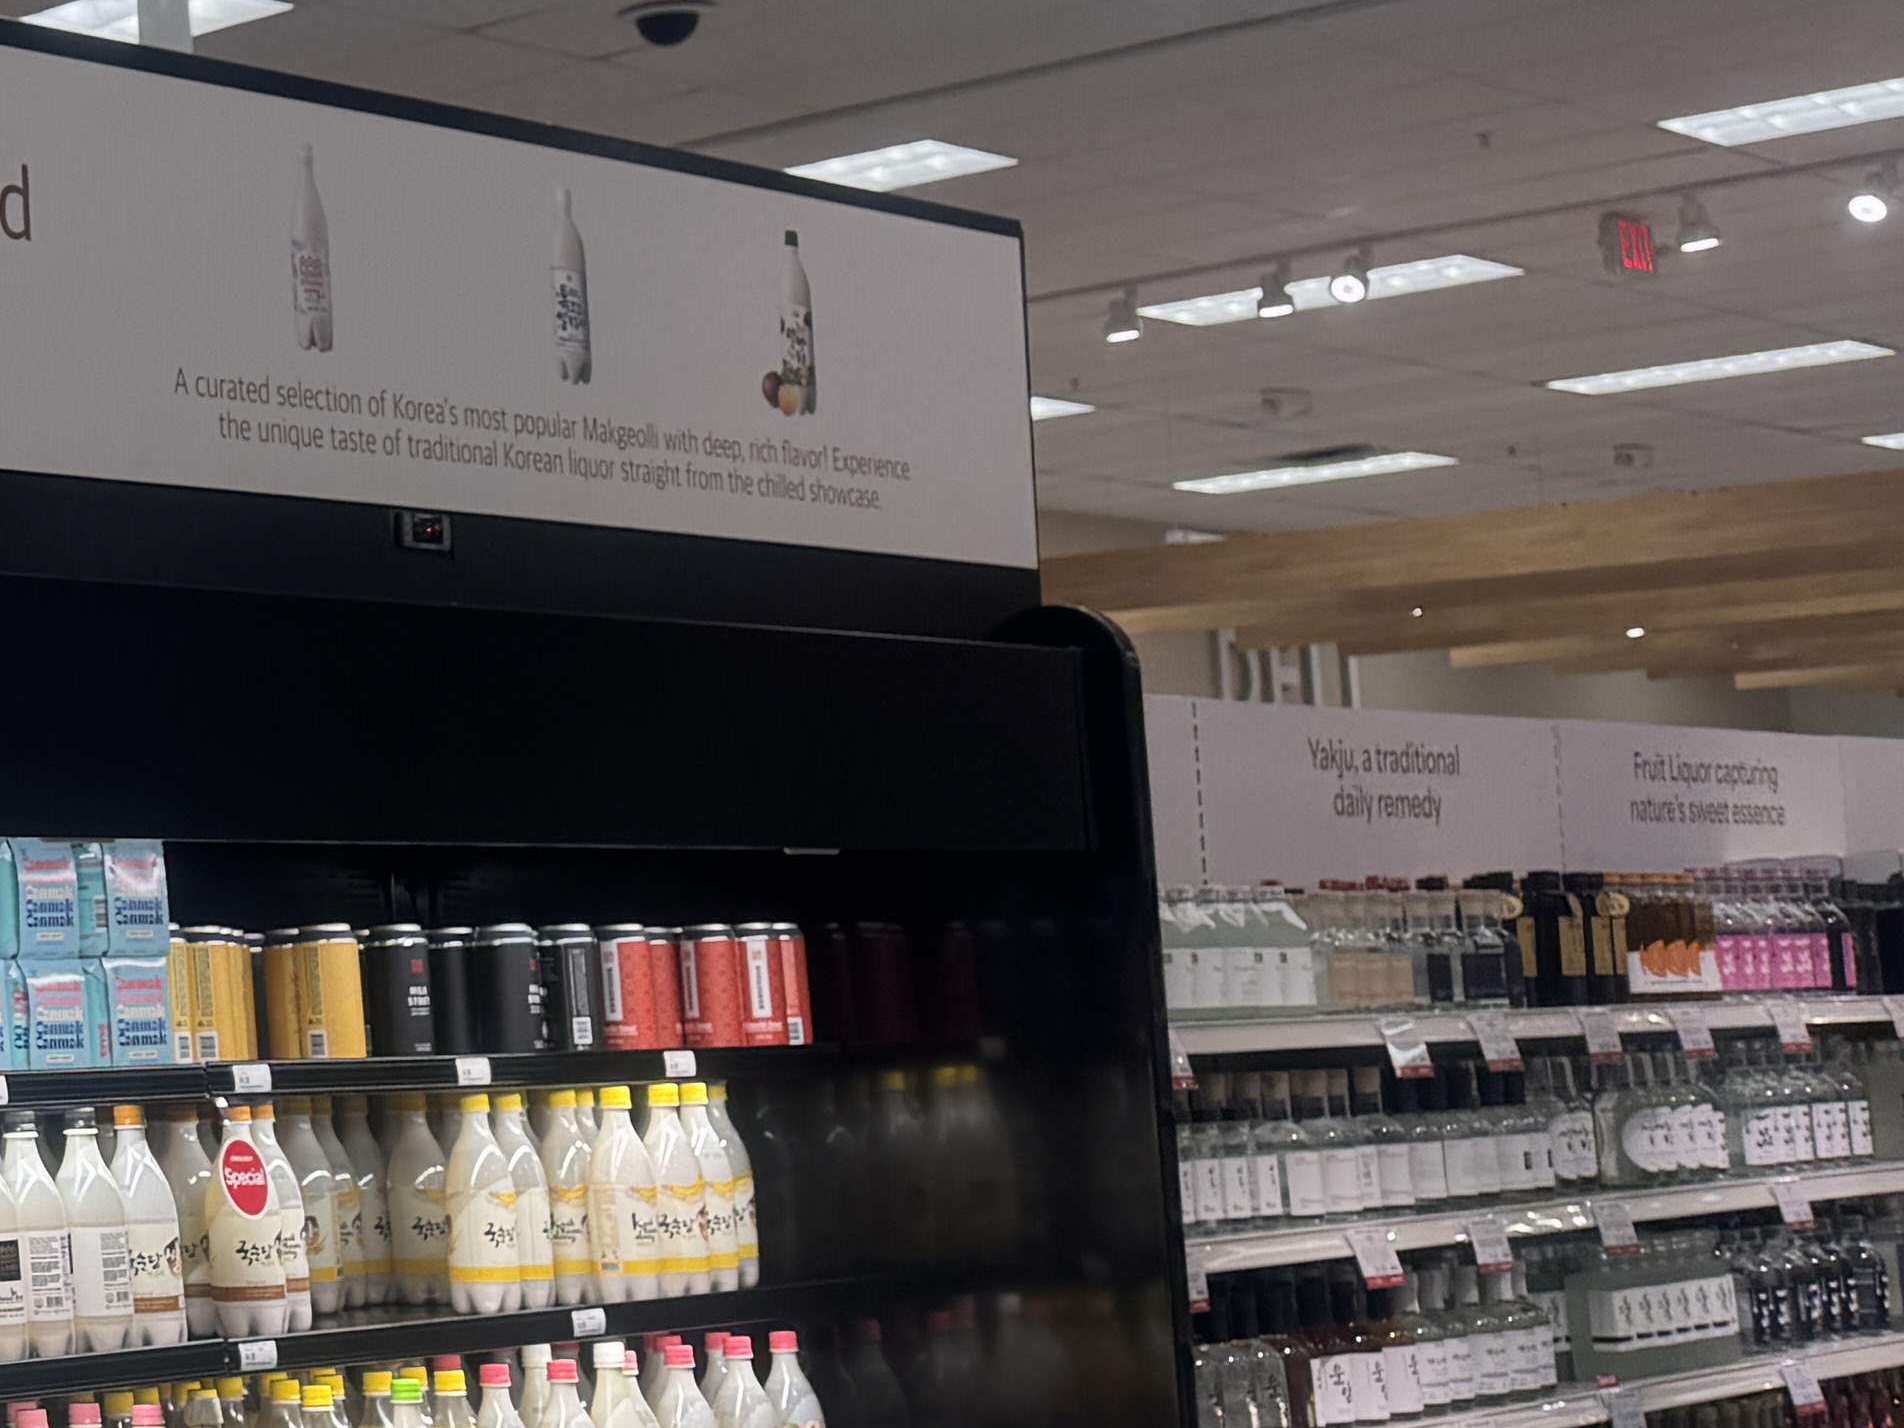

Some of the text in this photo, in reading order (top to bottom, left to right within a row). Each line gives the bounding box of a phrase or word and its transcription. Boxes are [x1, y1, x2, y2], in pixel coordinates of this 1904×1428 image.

[174, 367, 911, 481] A curated selection of Korea's most popular Makgeolli with deep, rich flavor! Experience
[219, 411, 883, 510] the unique taste of traditional Korean liquor straight from the chilled showcase.
[1307, 737, 1460, 779] Yakju, a traditional
[1633, 751, 1779, 793] Fruit Liquor capturing
[1333, 785, 1442, 825] daily remedy
[1630, 795, 1786, 825] nature's sweet essence
[225, 1168, 265, 1189] Special
